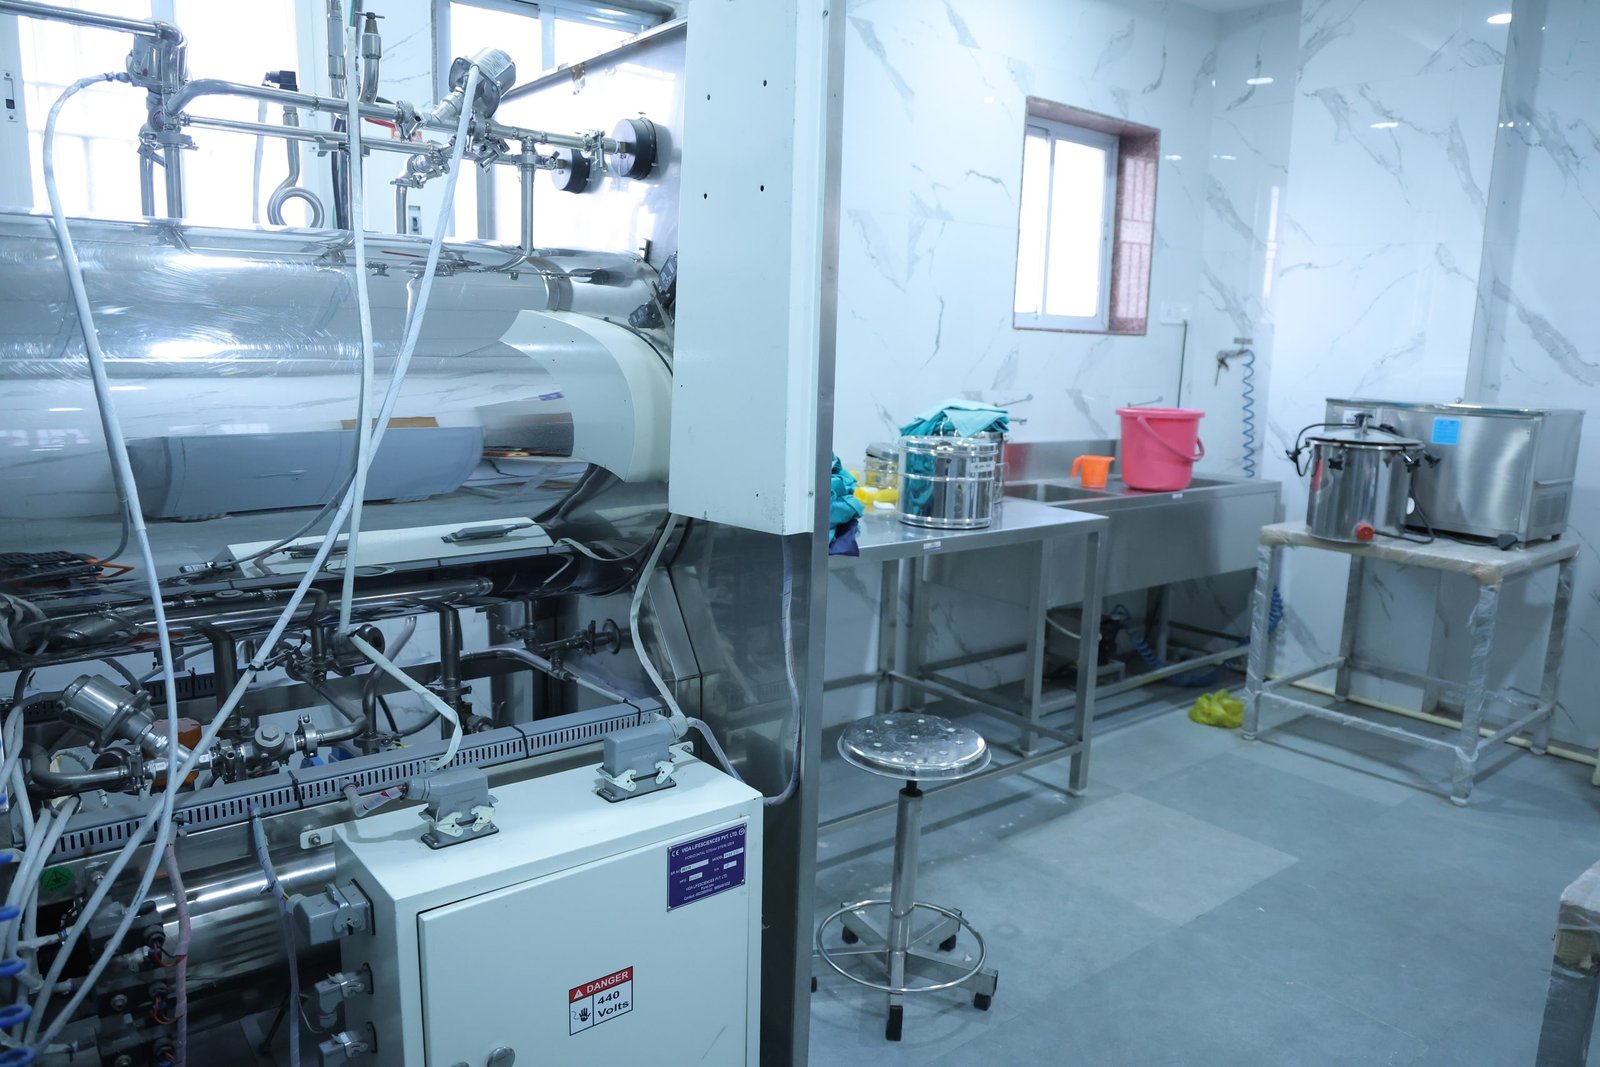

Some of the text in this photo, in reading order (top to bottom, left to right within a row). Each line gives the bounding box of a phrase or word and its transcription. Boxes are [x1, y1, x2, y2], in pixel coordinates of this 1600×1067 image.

[681, 845, 691, 853] VIDA
[692, 836, 720, 849] LIFESCIENCES
[587, 971, 629, 994] DANGER
[597, 990, 620, 1004] 440
[598, 1001, 629, 1017] Volts
